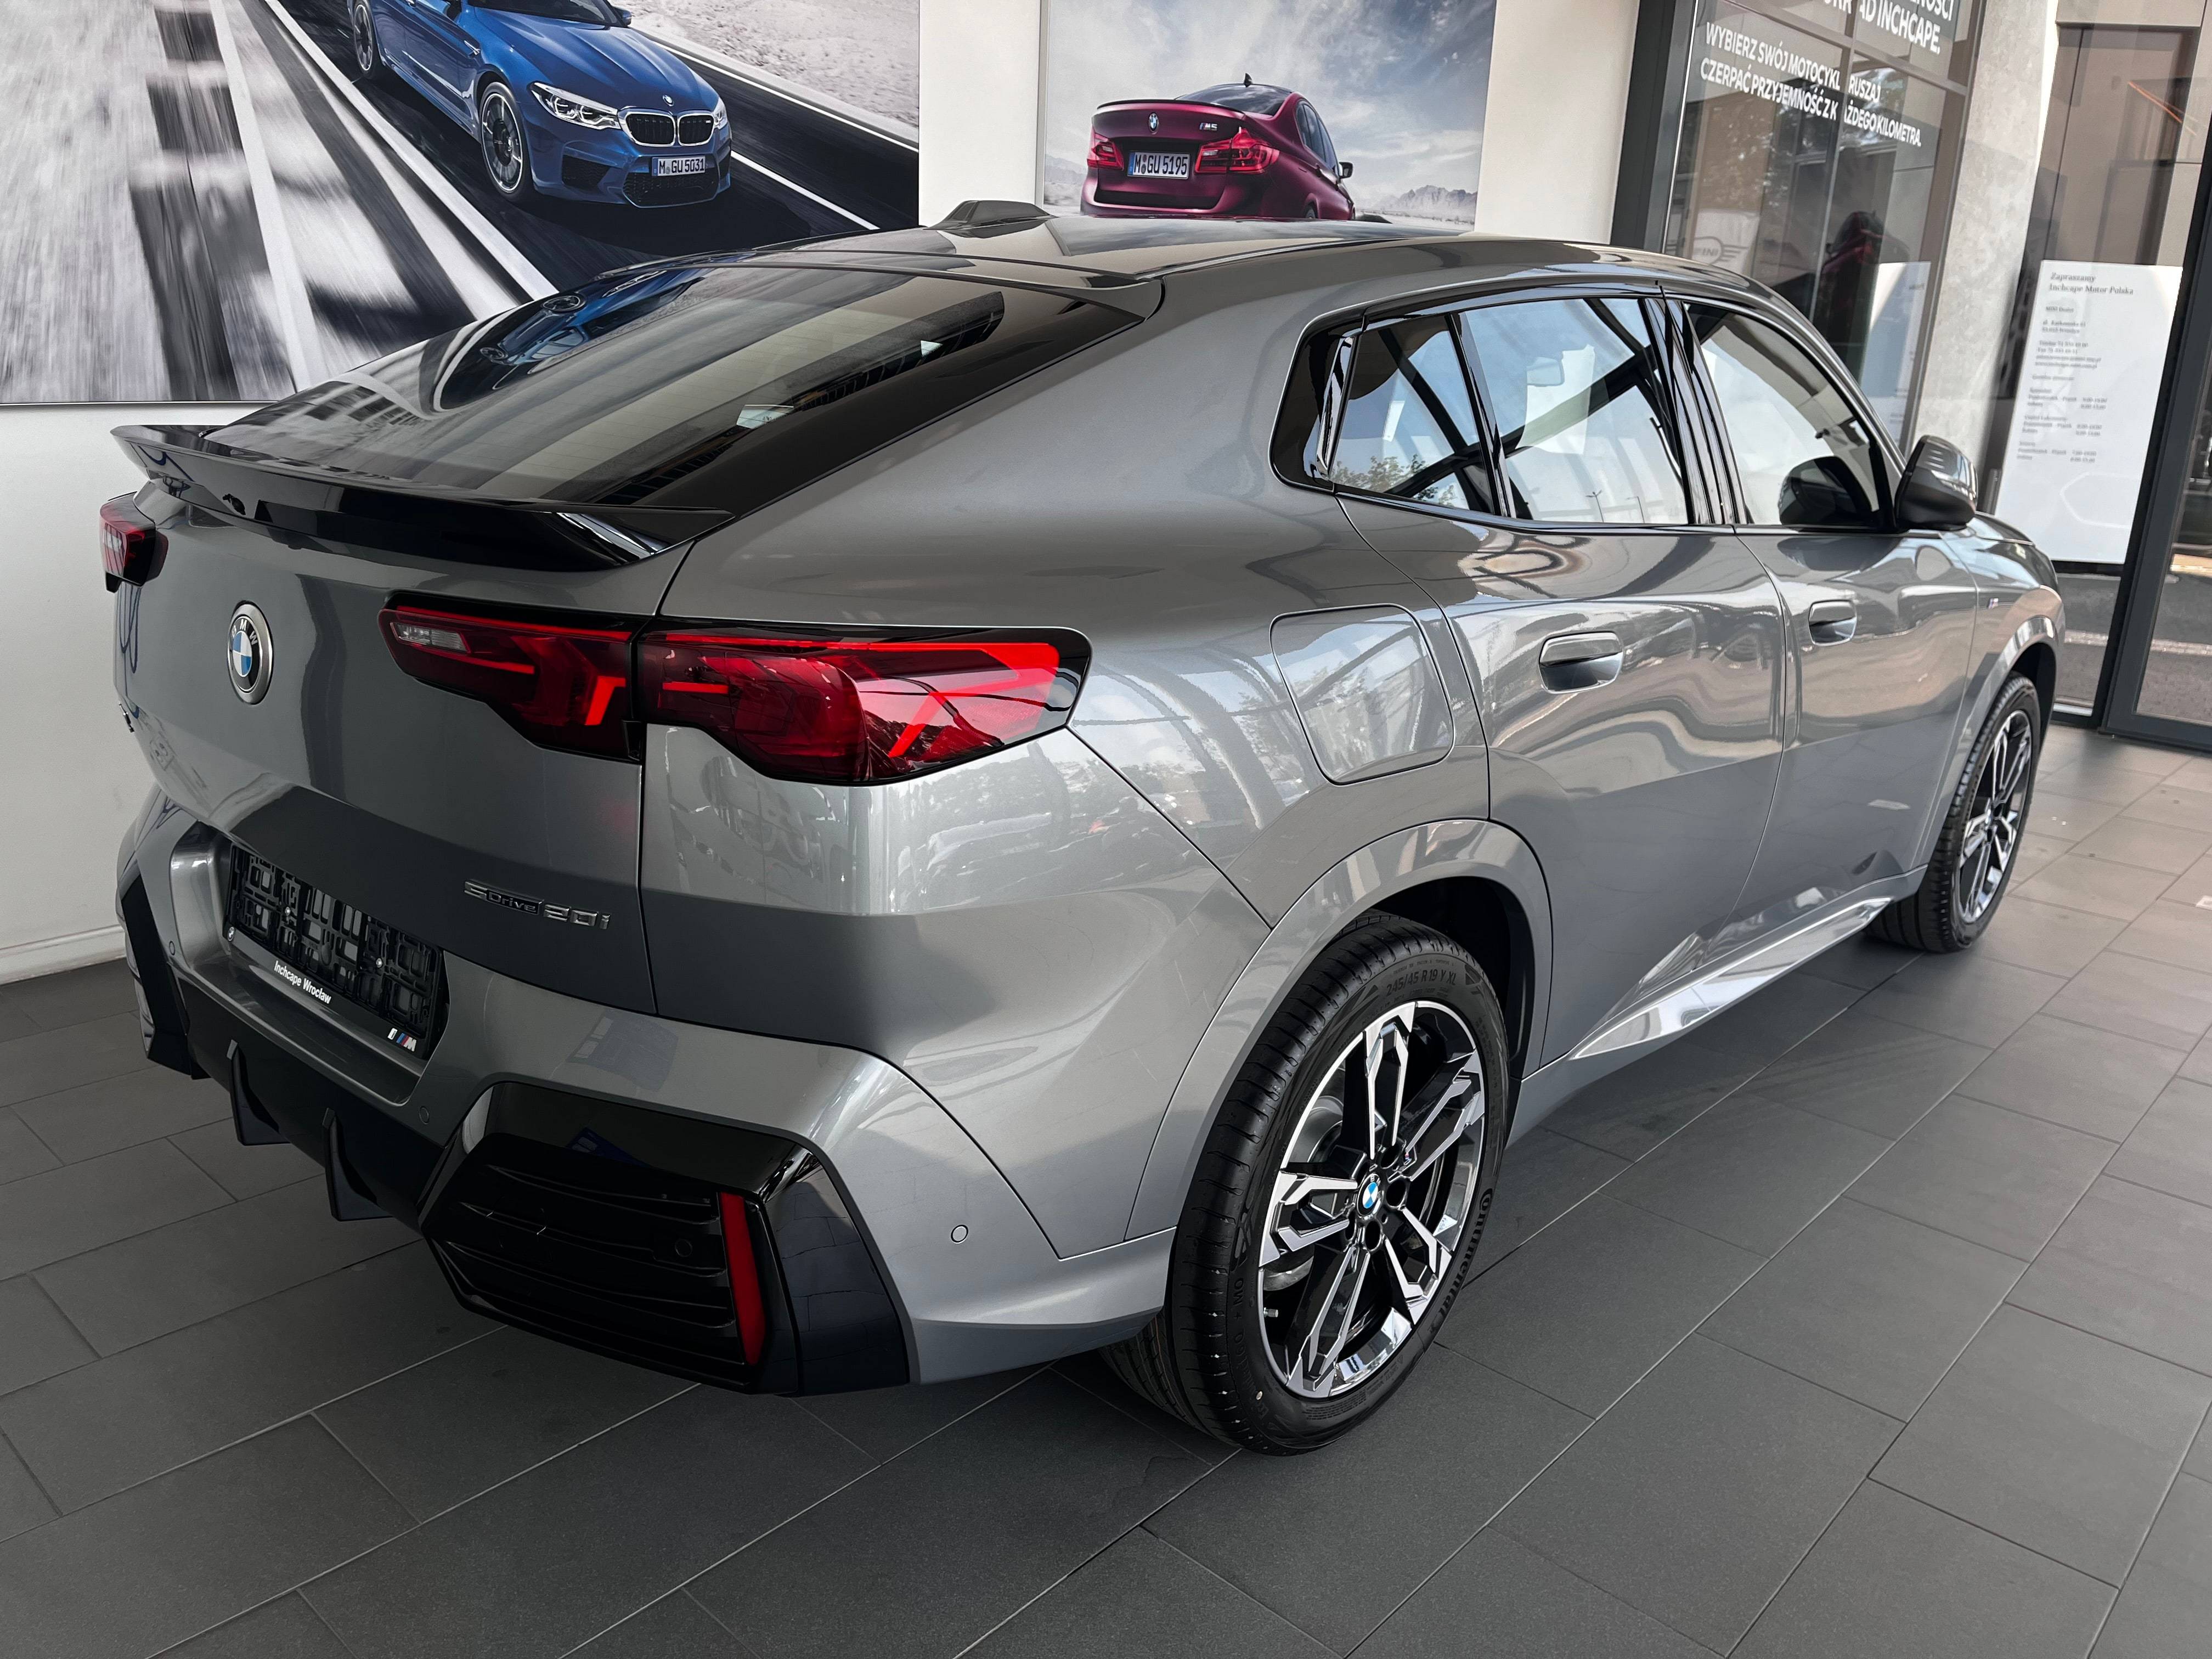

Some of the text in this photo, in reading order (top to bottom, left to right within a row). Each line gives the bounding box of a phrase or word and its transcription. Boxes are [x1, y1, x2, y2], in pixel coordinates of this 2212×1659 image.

[1706, 22, 1881, 103] WYBIERZ SWÓJ MOTOCYKL RUSZAJ
[1701, 57, 1752, 93] CZERPAĆ
[1750, 74, 1824, 117] PRZYJEMNOŚĆ
[685, 159, 704, 172] 5031
[1163, 155, 1188, 175] 5195
[274, 960, 302, 987] Inchcape
